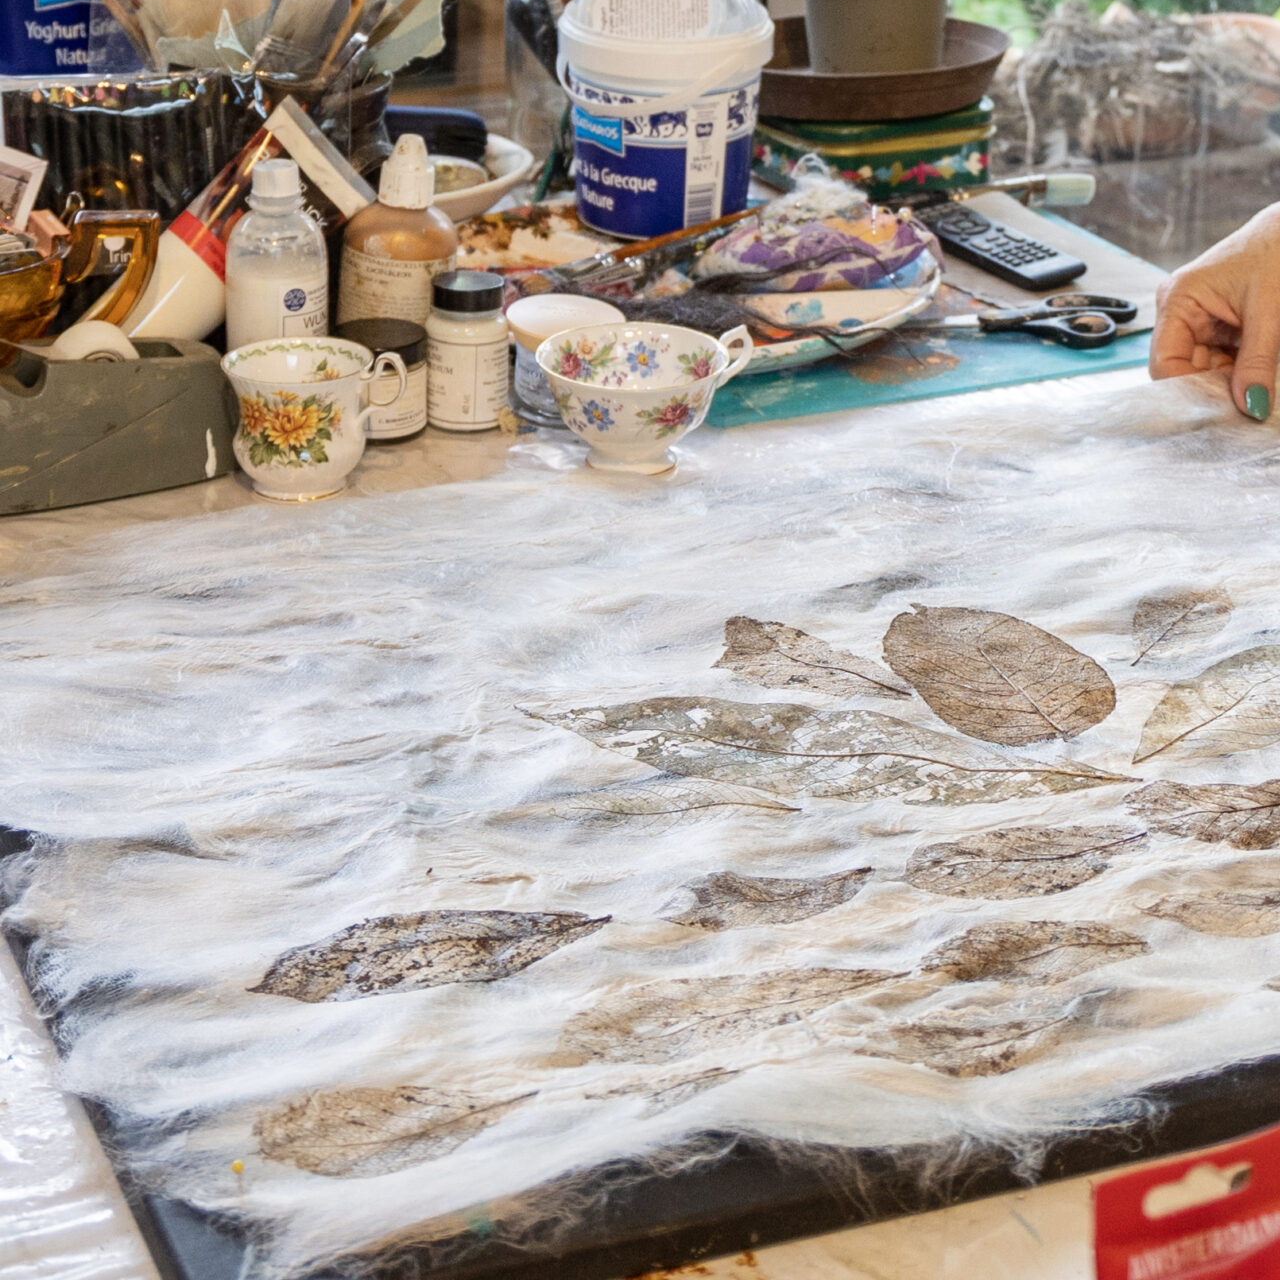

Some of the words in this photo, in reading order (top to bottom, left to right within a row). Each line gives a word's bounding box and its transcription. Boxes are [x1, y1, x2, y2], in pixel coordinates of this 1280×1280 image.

[24, 20, 87, 44] Yoghurt
[590, 163, 600, 182] la
[601, 167, 658, 194] Grecque
